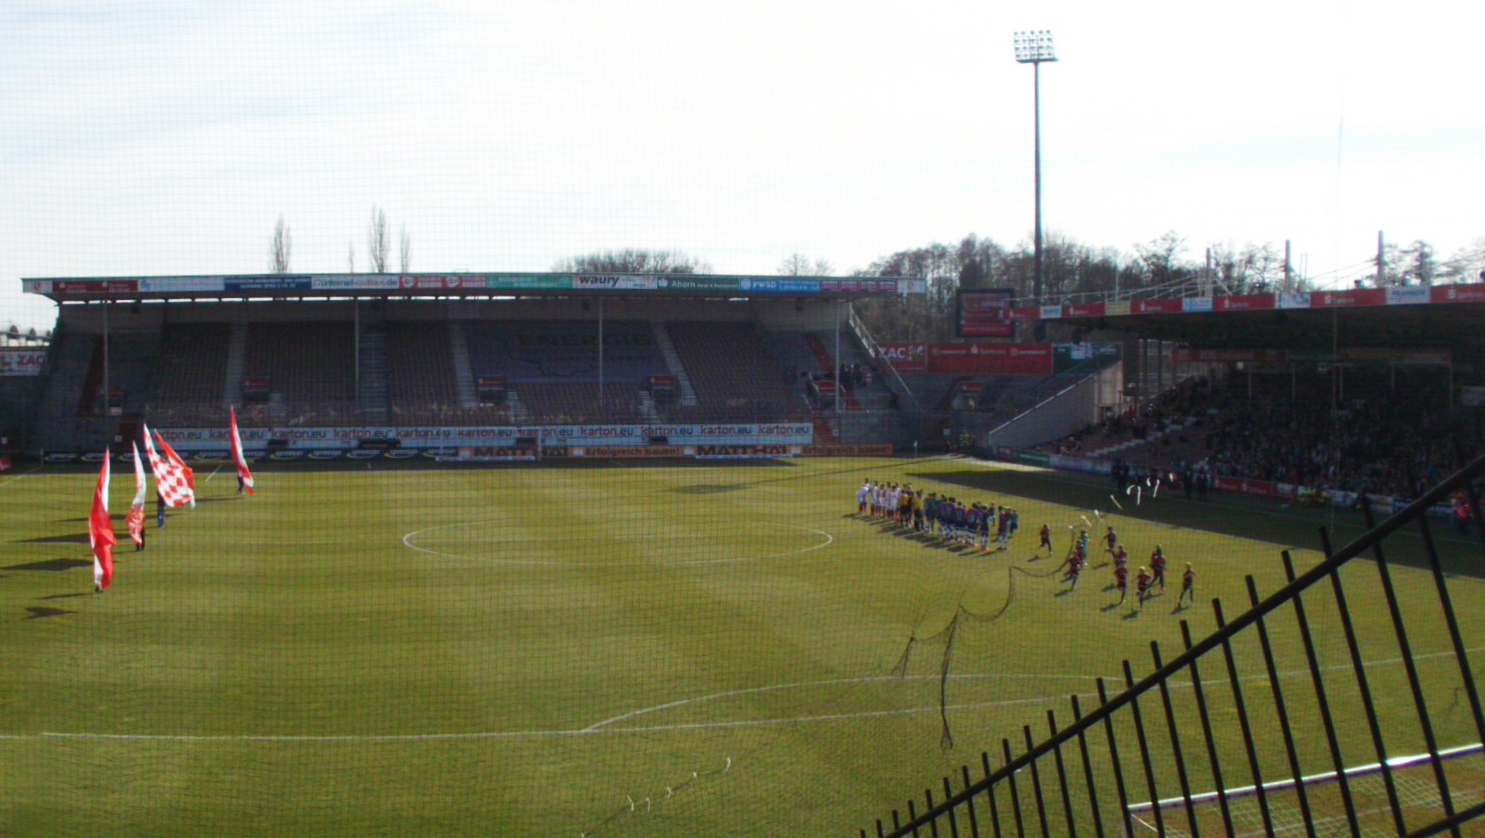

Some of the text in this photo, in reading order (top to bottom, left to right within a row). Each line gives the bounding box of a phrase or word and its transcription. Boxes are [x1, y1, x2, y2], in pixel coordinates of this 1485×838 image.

[579, 275, 619, 287] waury
[671, 279, 695, 288] Ahorn
[581, 427, 634, 436] karton.eu
[641, 426, 694, 436] karton.eu
[700, 425, 753, 435] karton.eu
[758, 424, 810, 435] karton.eu
